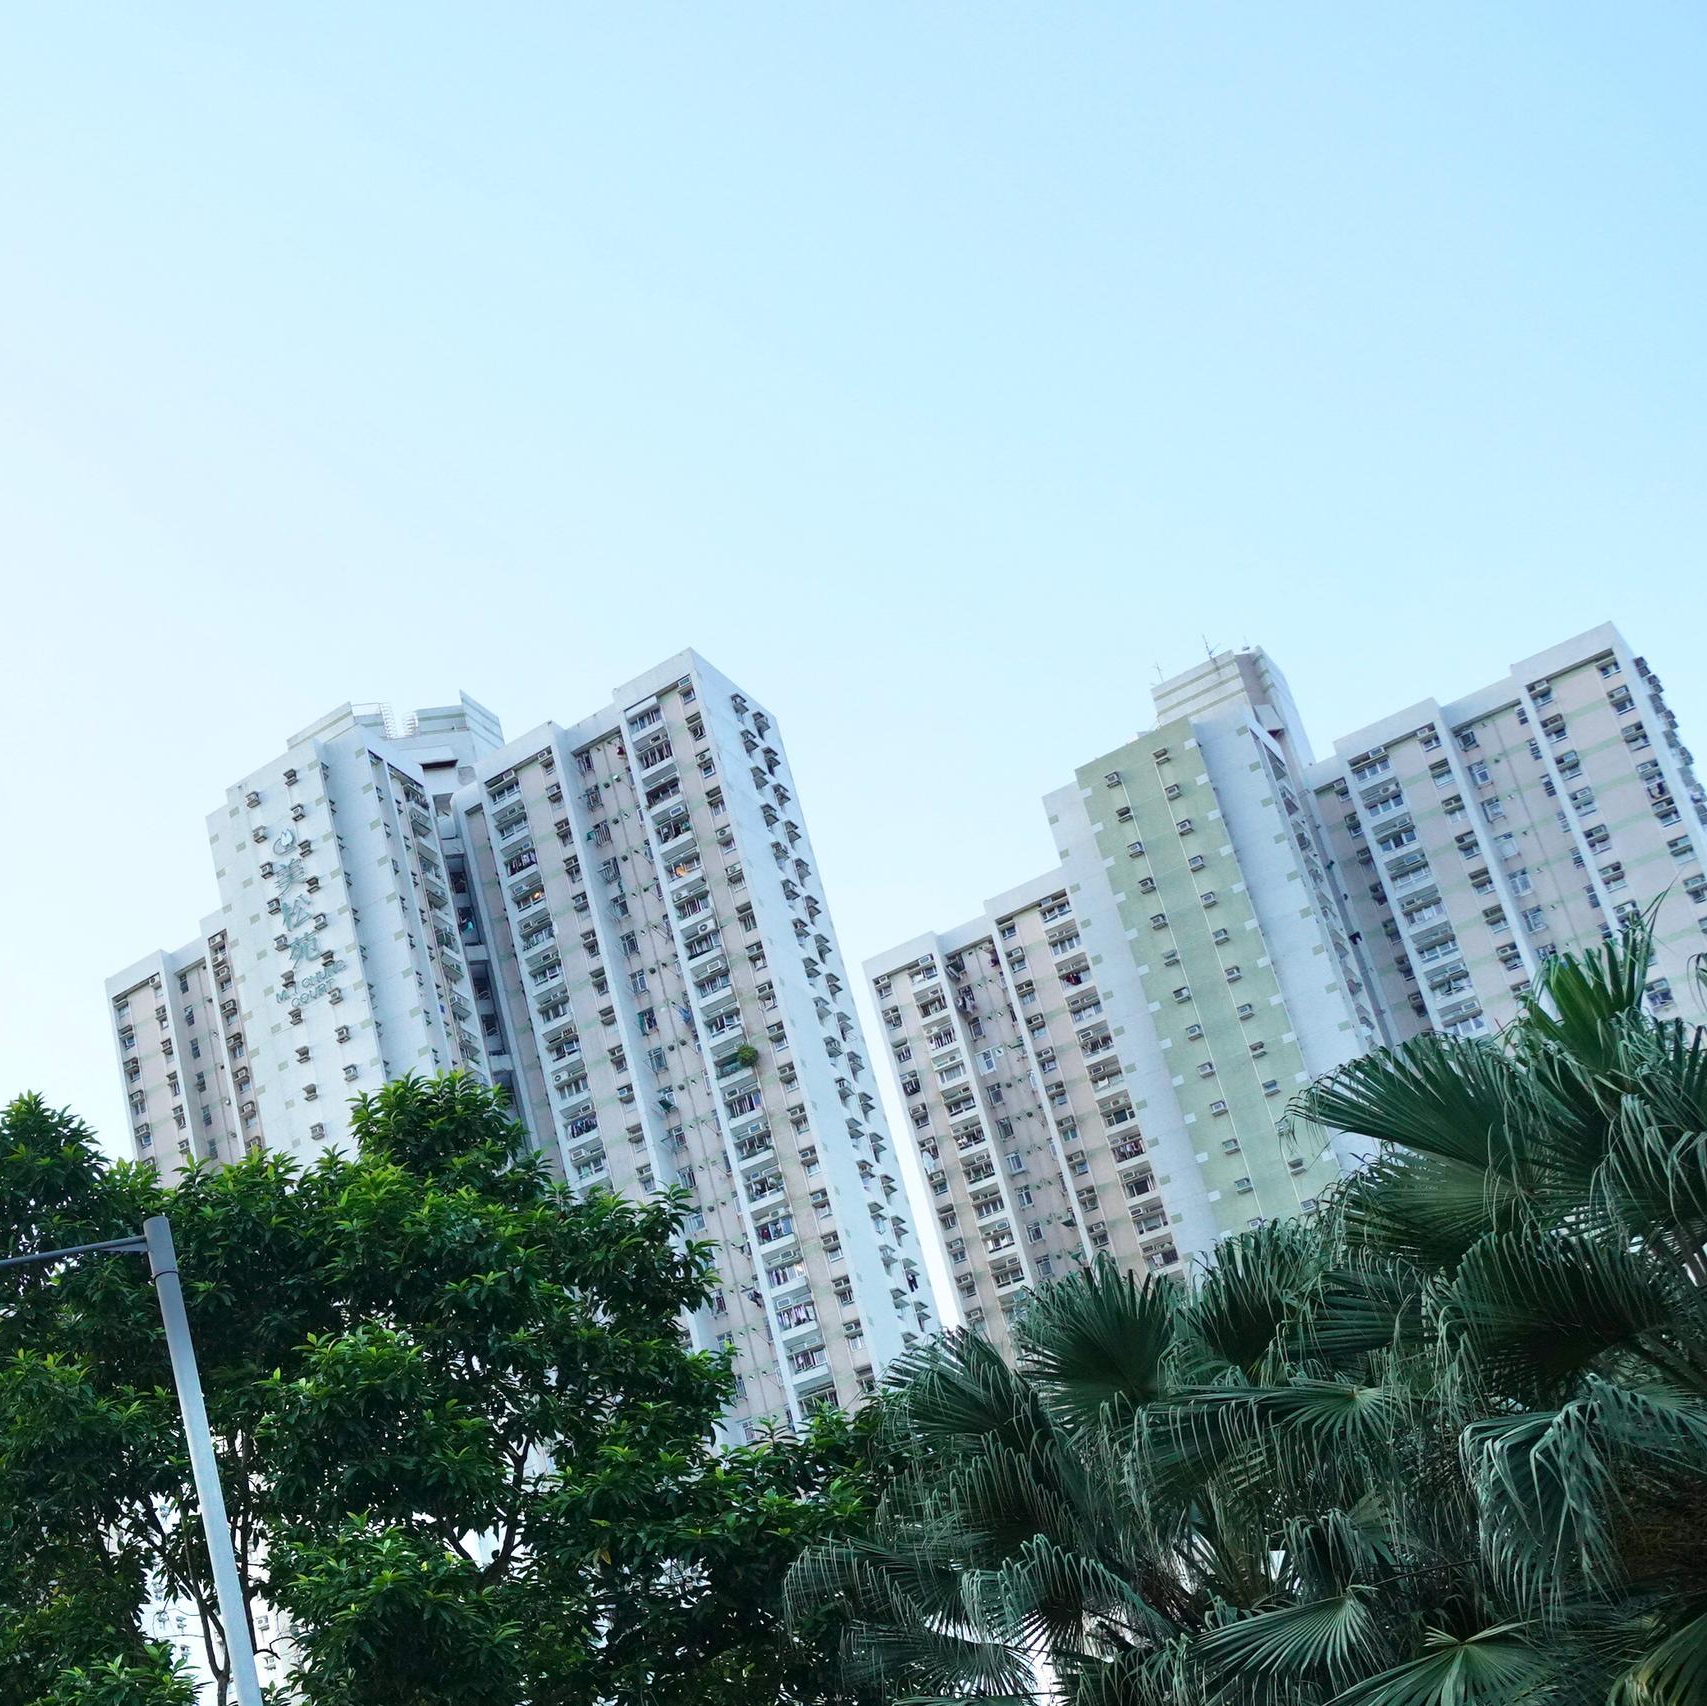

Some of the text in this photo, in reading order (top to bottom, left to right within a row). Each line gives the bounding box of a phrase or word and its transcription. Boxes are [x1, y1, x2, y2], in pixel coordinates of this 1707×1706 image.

[273, 858, 321, 970] 美松苑
[291, 978, 334, 1007] COURT
